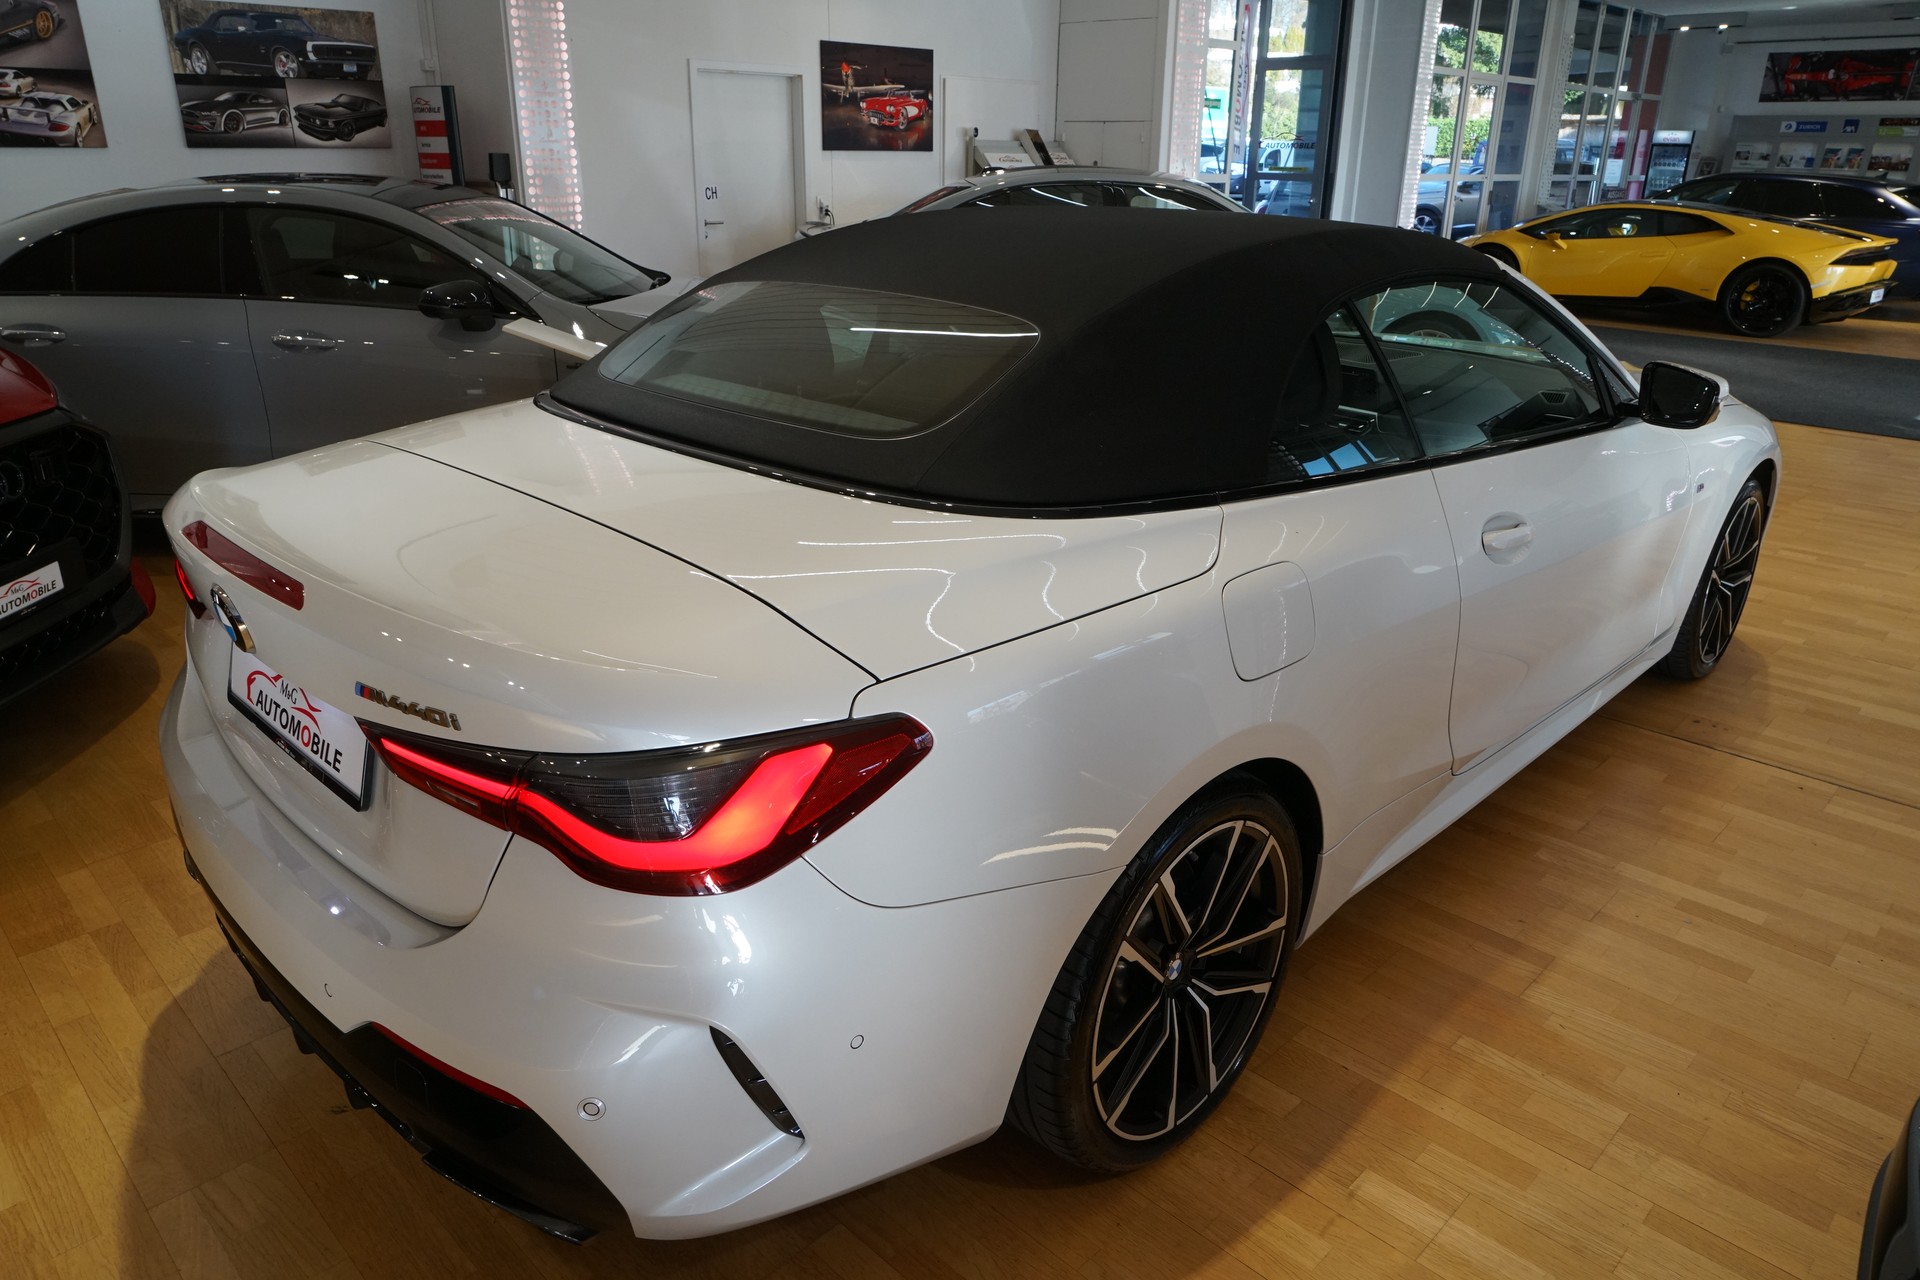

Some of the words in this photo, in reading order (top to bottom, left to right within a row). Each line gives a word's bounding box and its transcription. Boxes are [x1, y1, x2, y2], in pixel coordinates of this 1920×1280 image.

[705, 186, 718, 200] CH
[0, 580, 57, 615] UTOMOBILE
[255, 689, 343, 774] AUTOMOBILE
